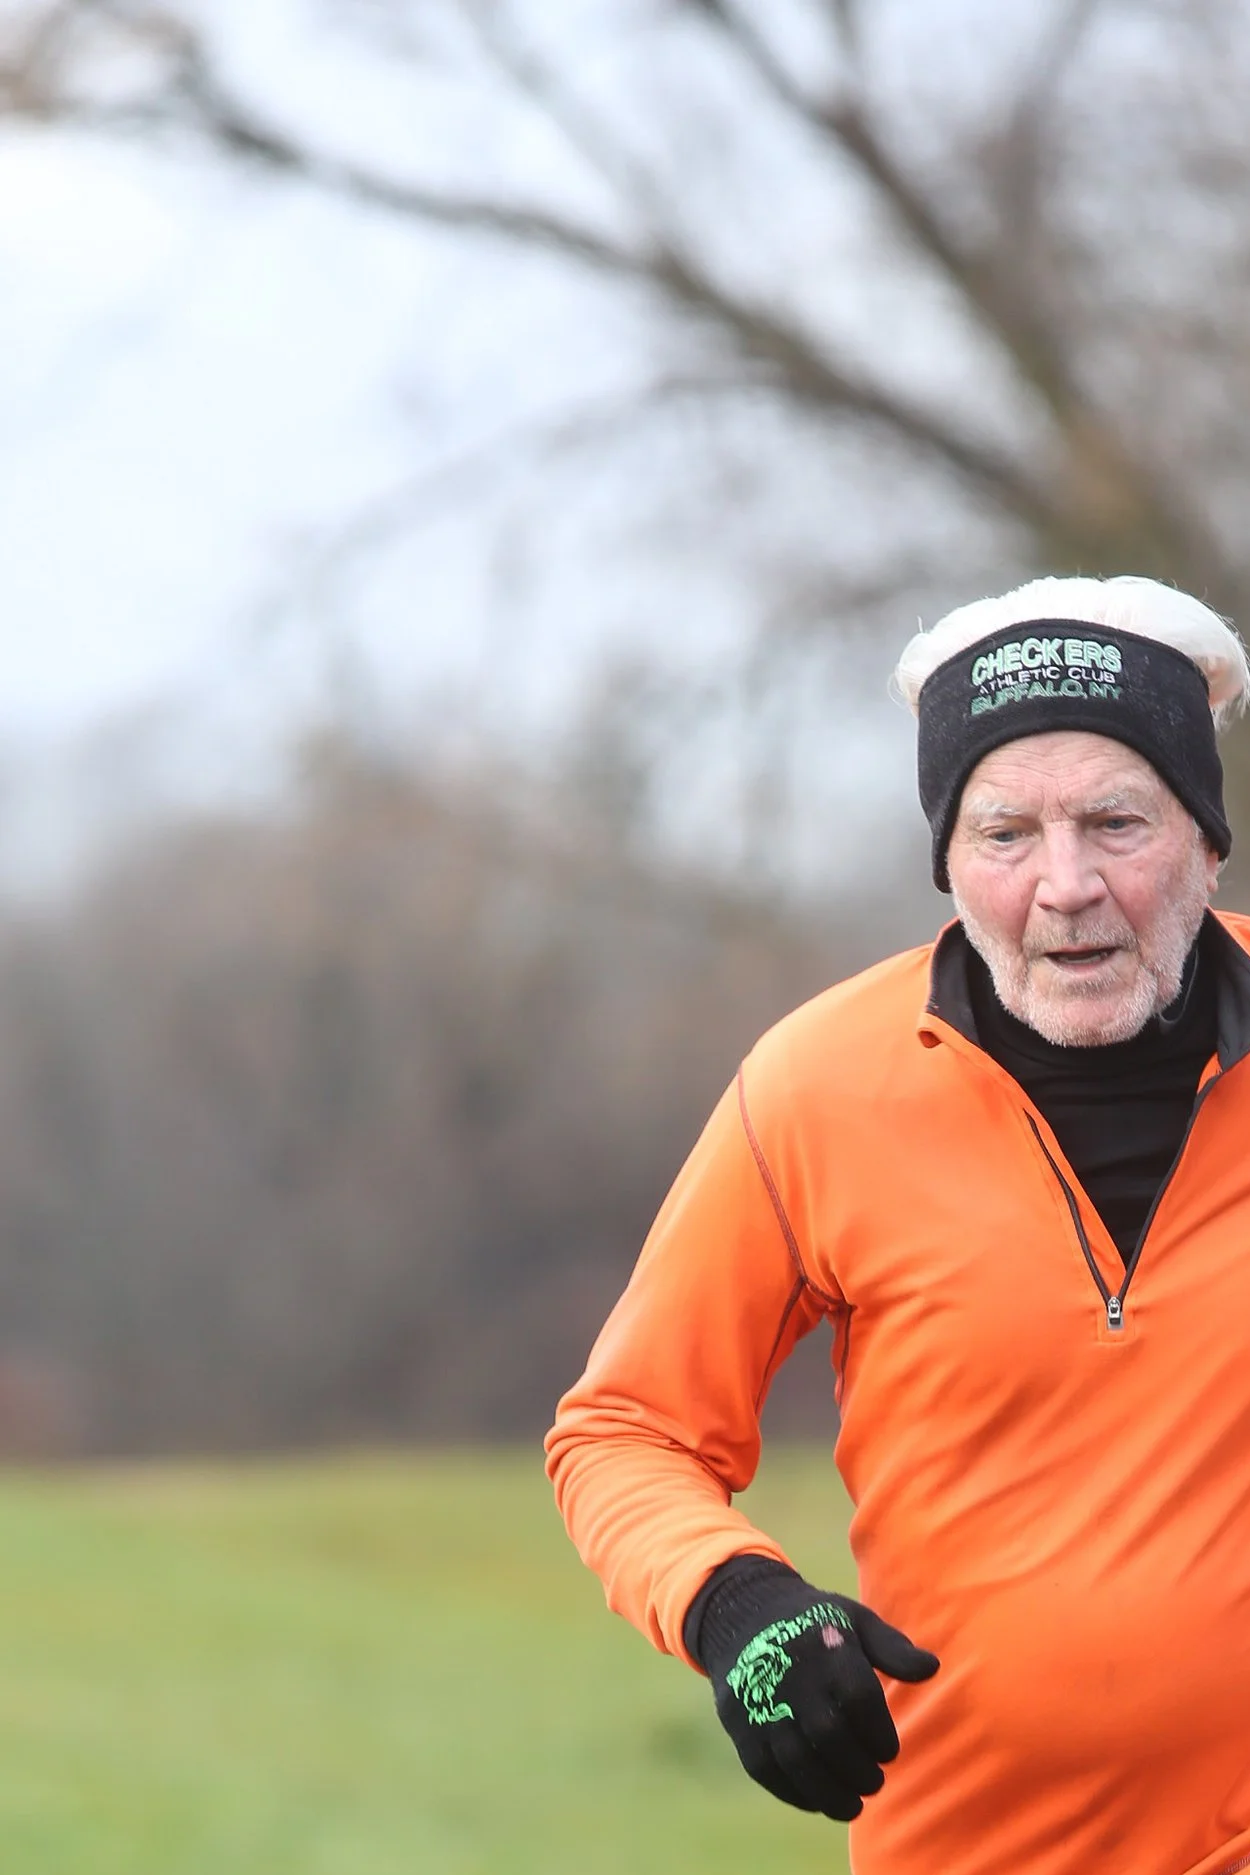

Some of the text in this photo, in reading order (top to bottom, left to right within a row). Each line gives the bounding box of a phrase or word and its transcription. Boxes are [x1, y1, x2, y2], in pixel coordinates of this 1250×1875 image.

[971, 637, 1122, 686] CHECKERS
[979, 666, 1116, 695] ATHLETIC CLUB
[1088, 681, 1123, 700] NY
